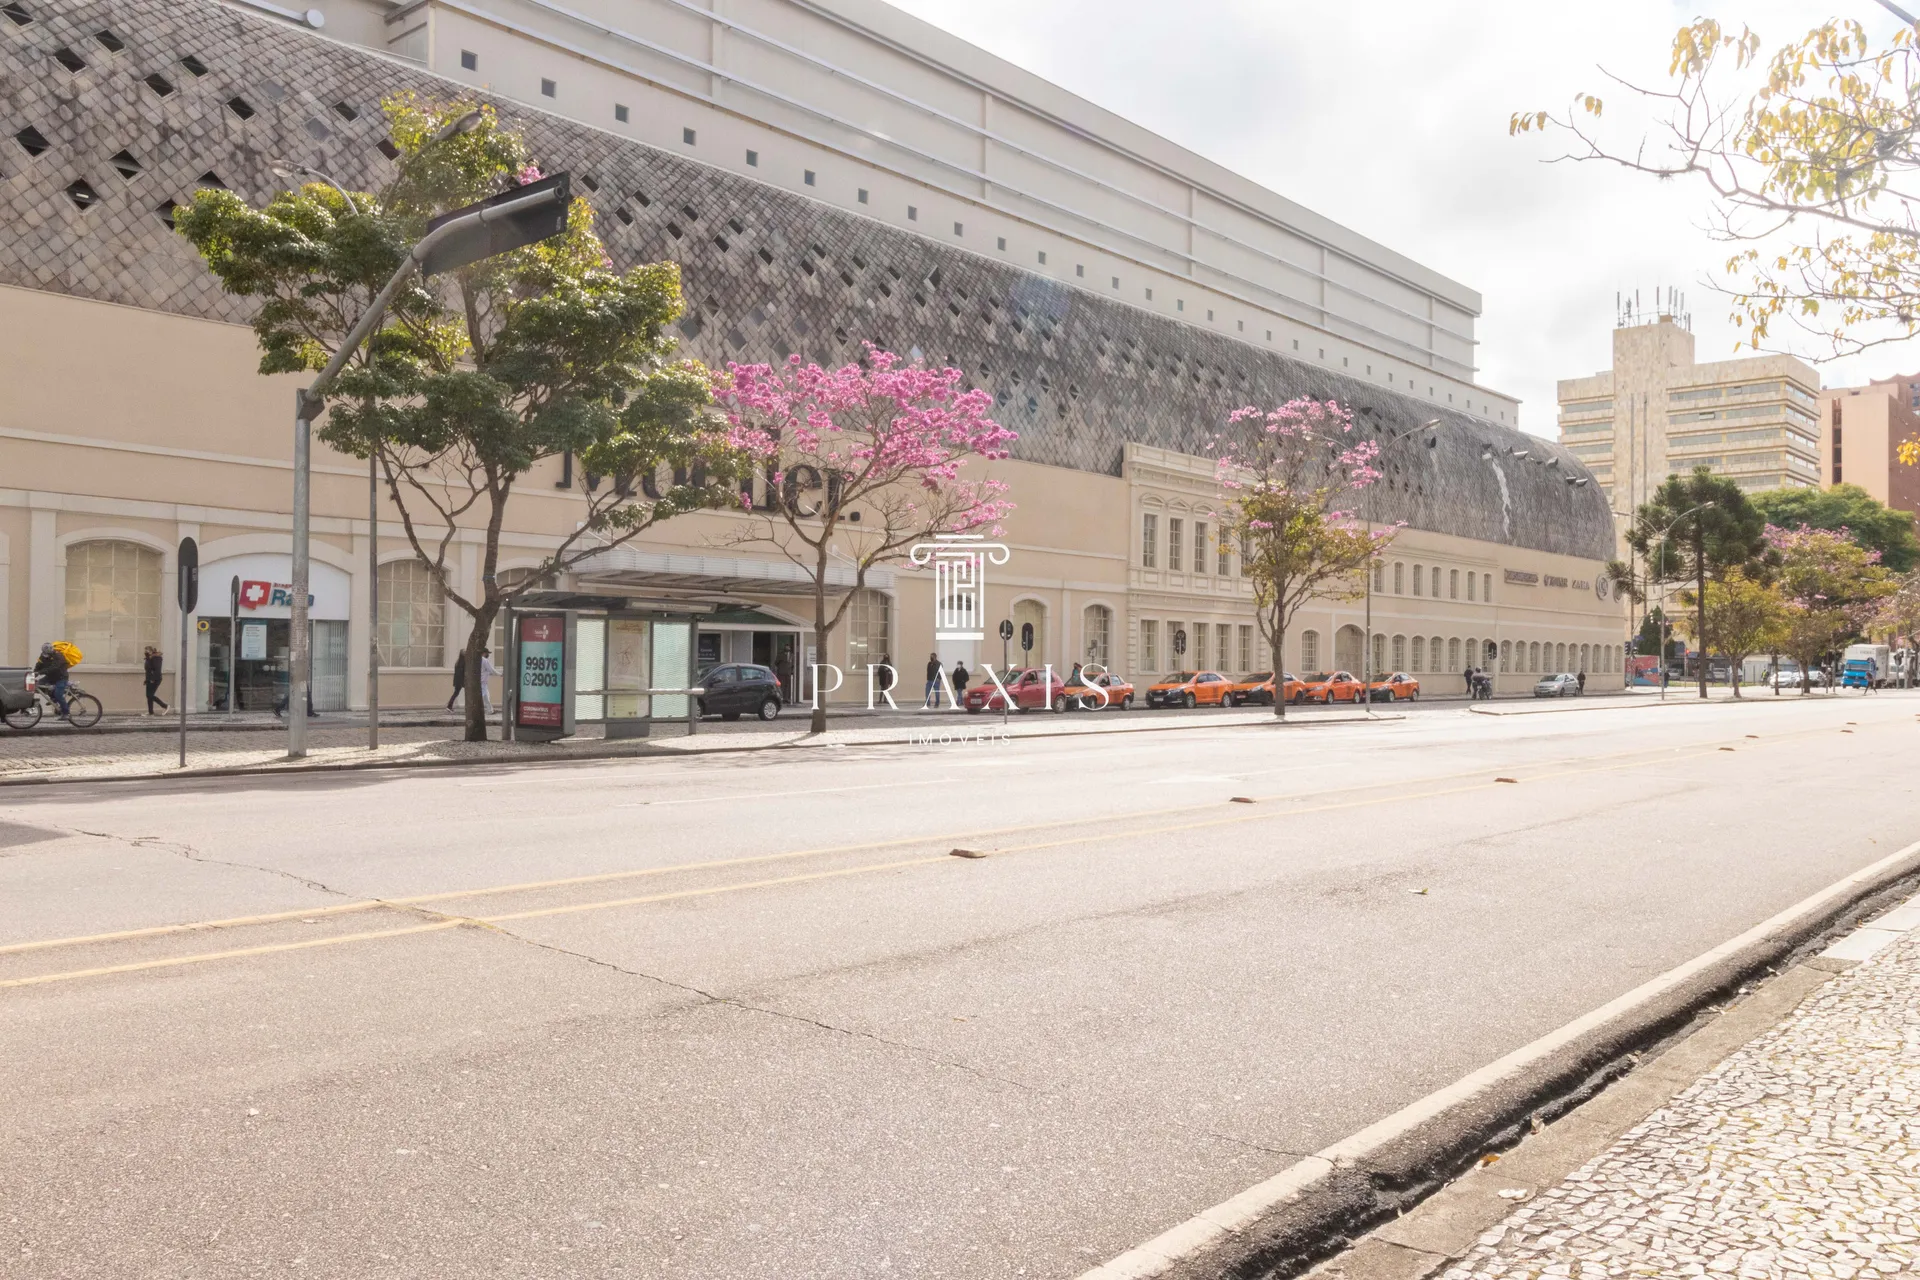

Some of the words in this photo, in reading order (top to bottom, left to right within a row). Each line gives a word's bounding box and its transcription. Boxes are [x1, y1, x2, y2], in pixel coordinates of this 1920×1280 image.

[270, 588, 315, 607] Raa
[526, 656, 558, 671] 99876
[531, 673, 558, 687] 2903
